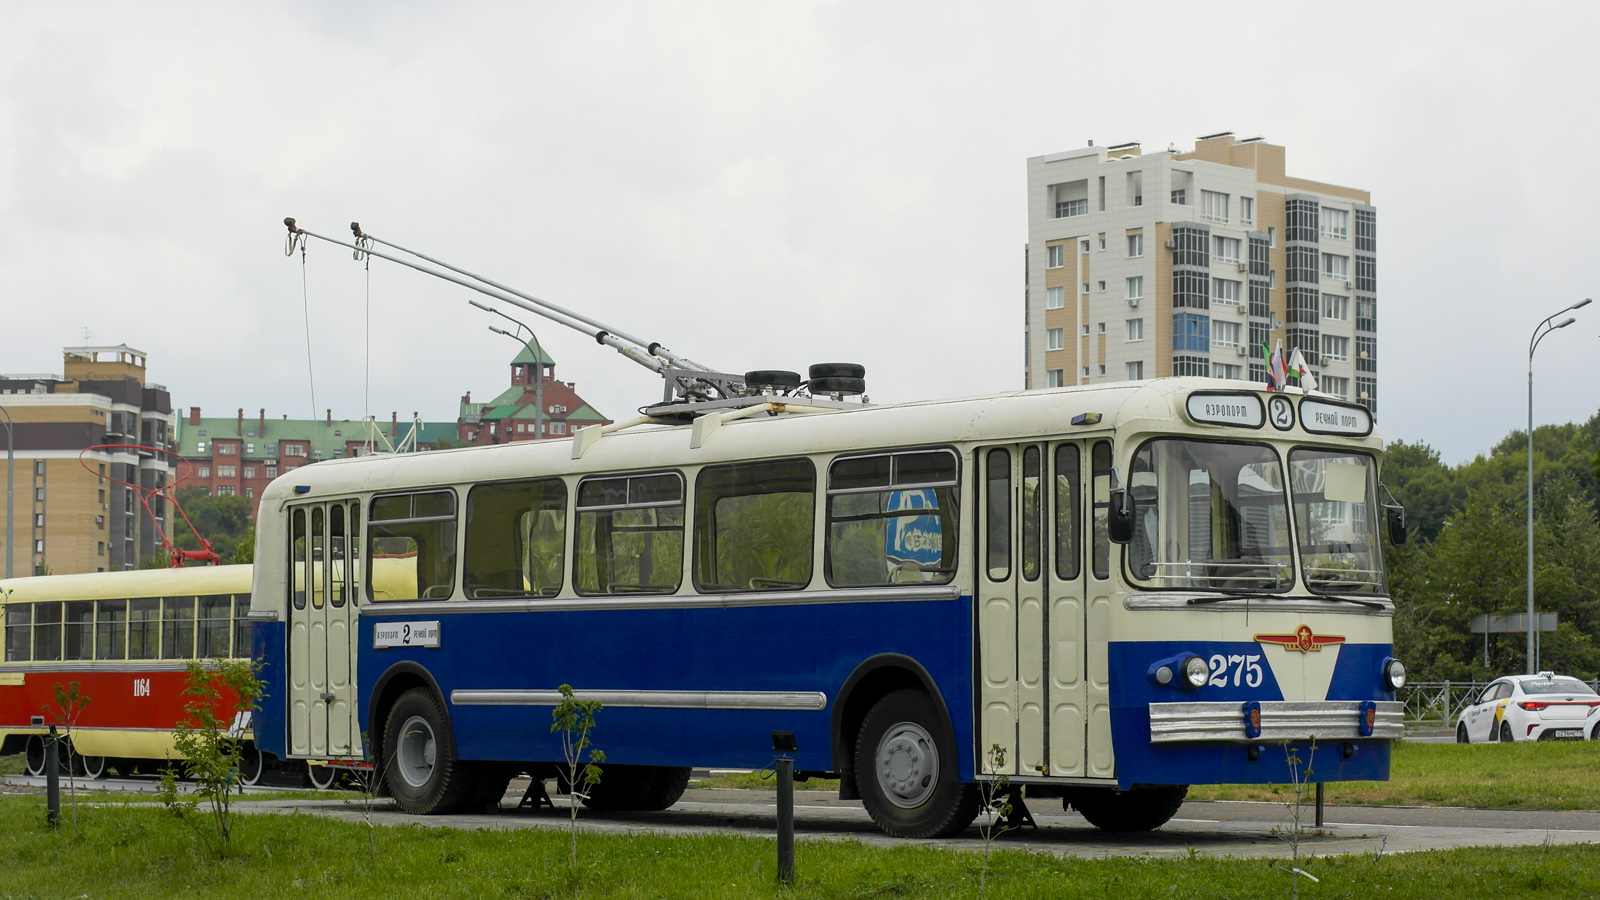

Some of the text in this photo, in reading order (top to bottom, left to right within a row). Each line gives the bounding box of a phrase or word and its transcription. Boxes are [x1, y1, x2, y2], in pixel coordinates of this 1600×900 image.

[1205, 403, 1248, 418] АЭРОПОРТ
[1274, 400, 1288, 425] 2
[1315, 411, 1358, 428] РЕЧНОЙ ПОРТ
[403, 624, 410, 644] 2
[1208, 654, 1263, 688] 275
[133, 678, 151, 697] 1164
